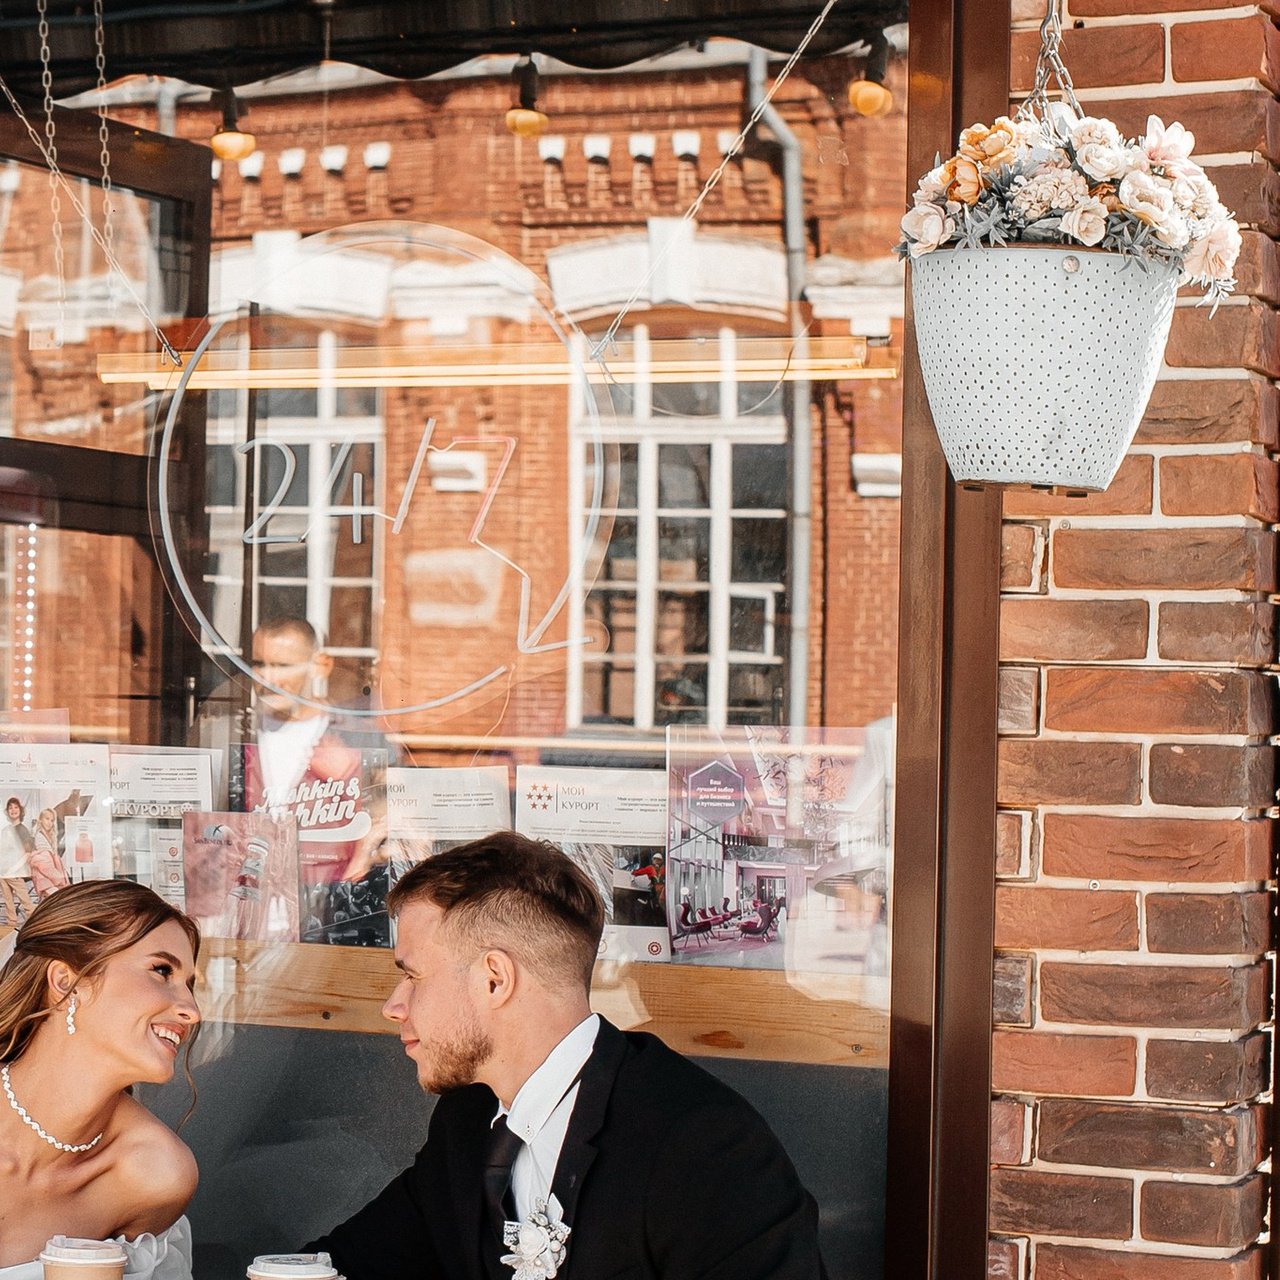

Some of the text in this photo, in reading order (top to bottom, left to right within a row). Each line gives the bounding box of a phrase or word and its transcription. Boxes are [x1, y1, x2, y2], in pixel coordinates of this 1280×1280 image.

[237, 418, 517, 544] 24/7
[110, 781, 130, 790] РОРТ
[561, 785, 585, 796] МОЙ
[124, 804, 177, 817] КУРОРТ
[561, 800, 600, 811] КУРОРТ
